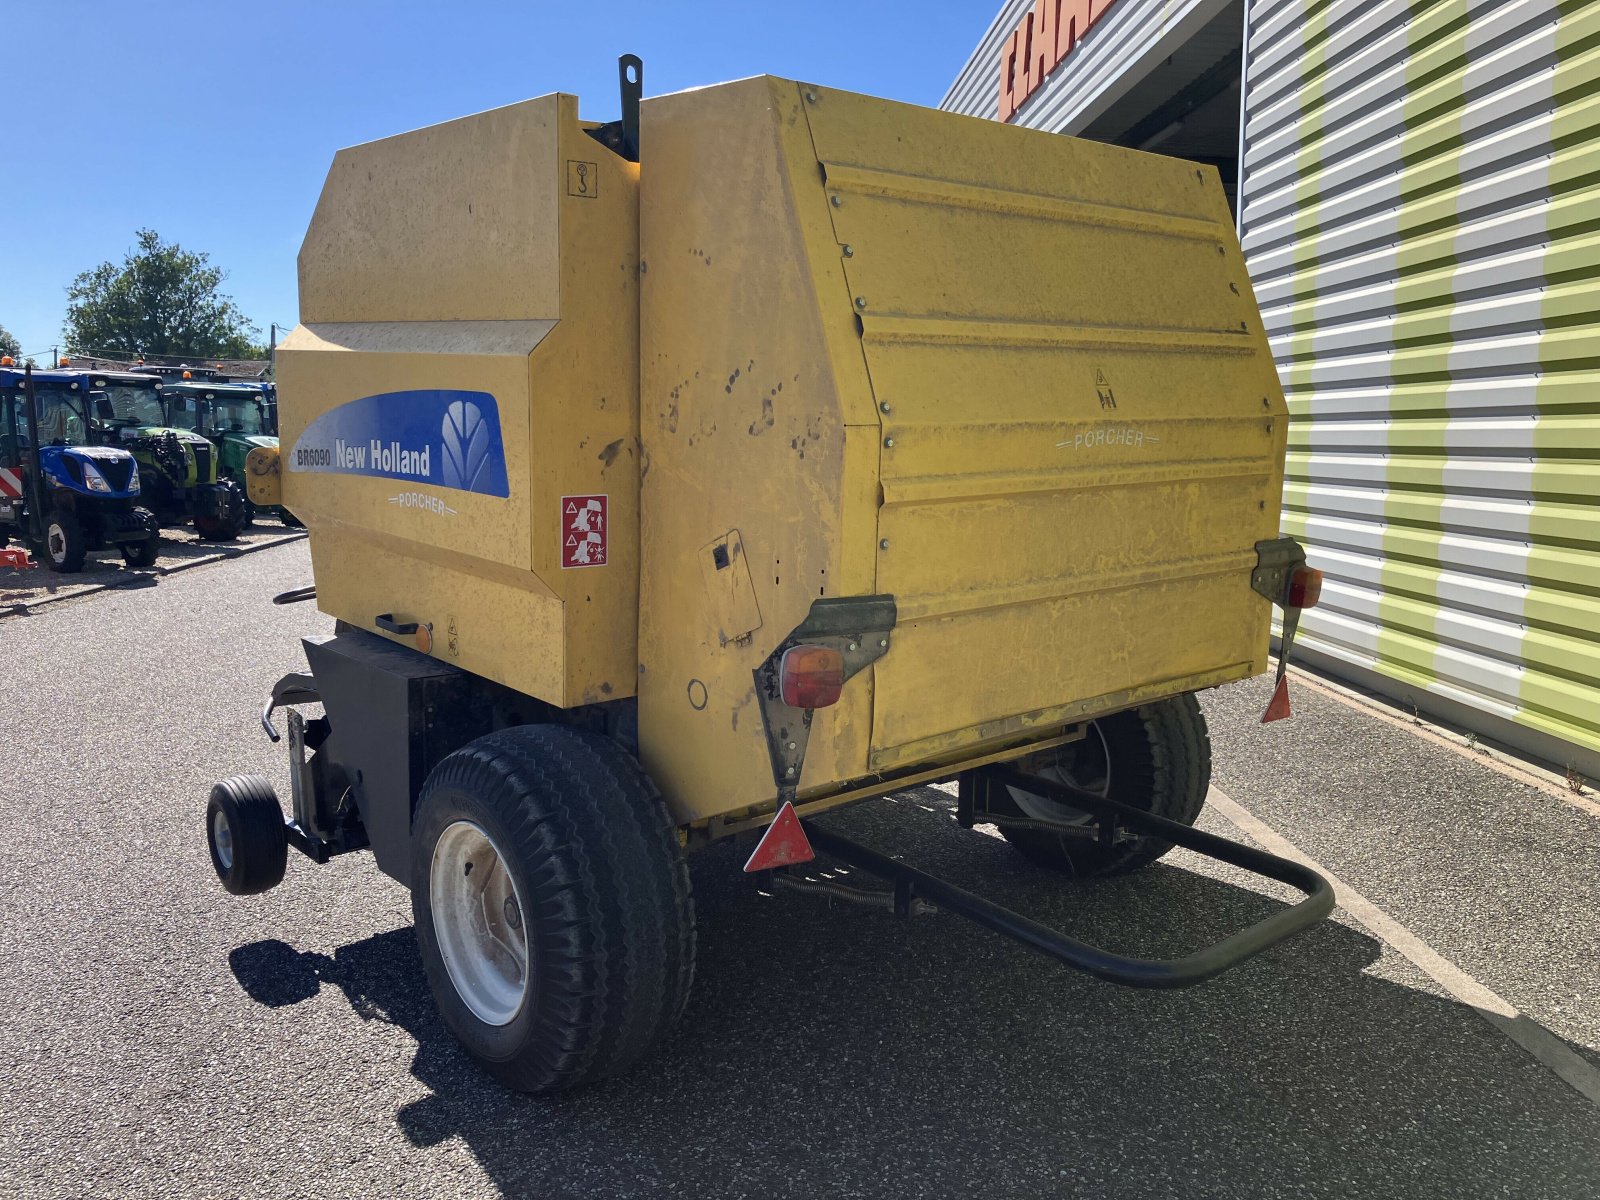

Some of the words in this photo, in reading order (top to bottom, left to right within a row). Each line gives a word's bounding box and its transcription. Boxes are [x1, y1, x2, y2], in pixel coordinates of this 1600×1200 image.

[998, 0, 1117, 123] CLAA
[1075, 429, 1144, 450] PORCHER
[297, 449, 331, 466] BR6090
[335, 438, 366, 468] New
[370, 439, 430, 477] Holland
[399, 493, 445, 517] PORCHER
